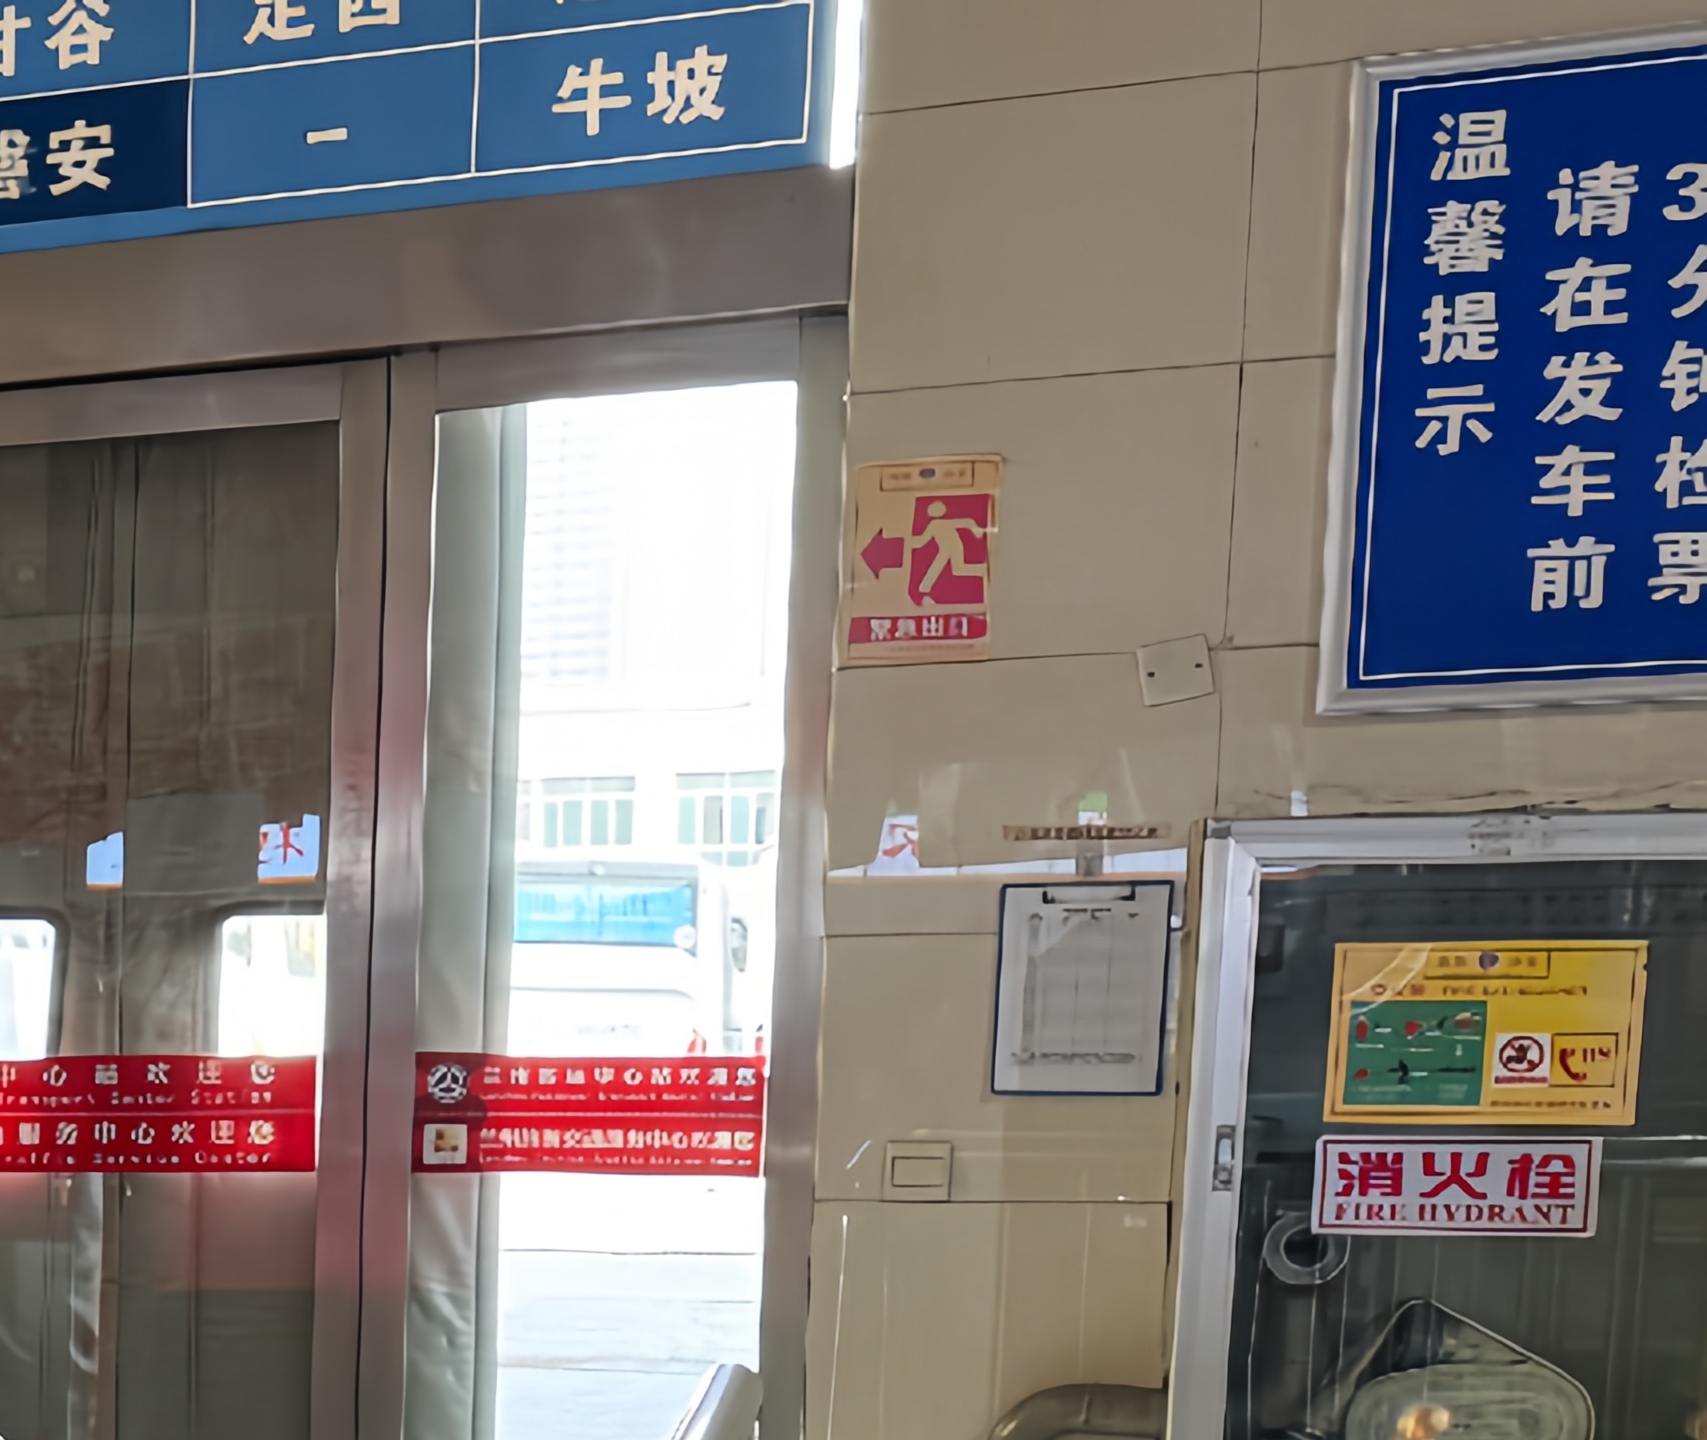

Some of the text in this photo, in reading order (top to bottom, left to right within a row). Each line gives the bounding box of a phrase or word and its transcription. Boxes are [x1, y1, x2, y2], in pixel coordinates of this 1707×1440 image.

[552, 45, 728, 136] 牛坡
[1415, 110, 1510, 455] 温馨提示
[1527, 161, 1639, 611] 请在发车前
[1335, 1203, 1576, 1225] FIRE HYDRANT
[1337, 1151, 1576, 1200] 消火栓
